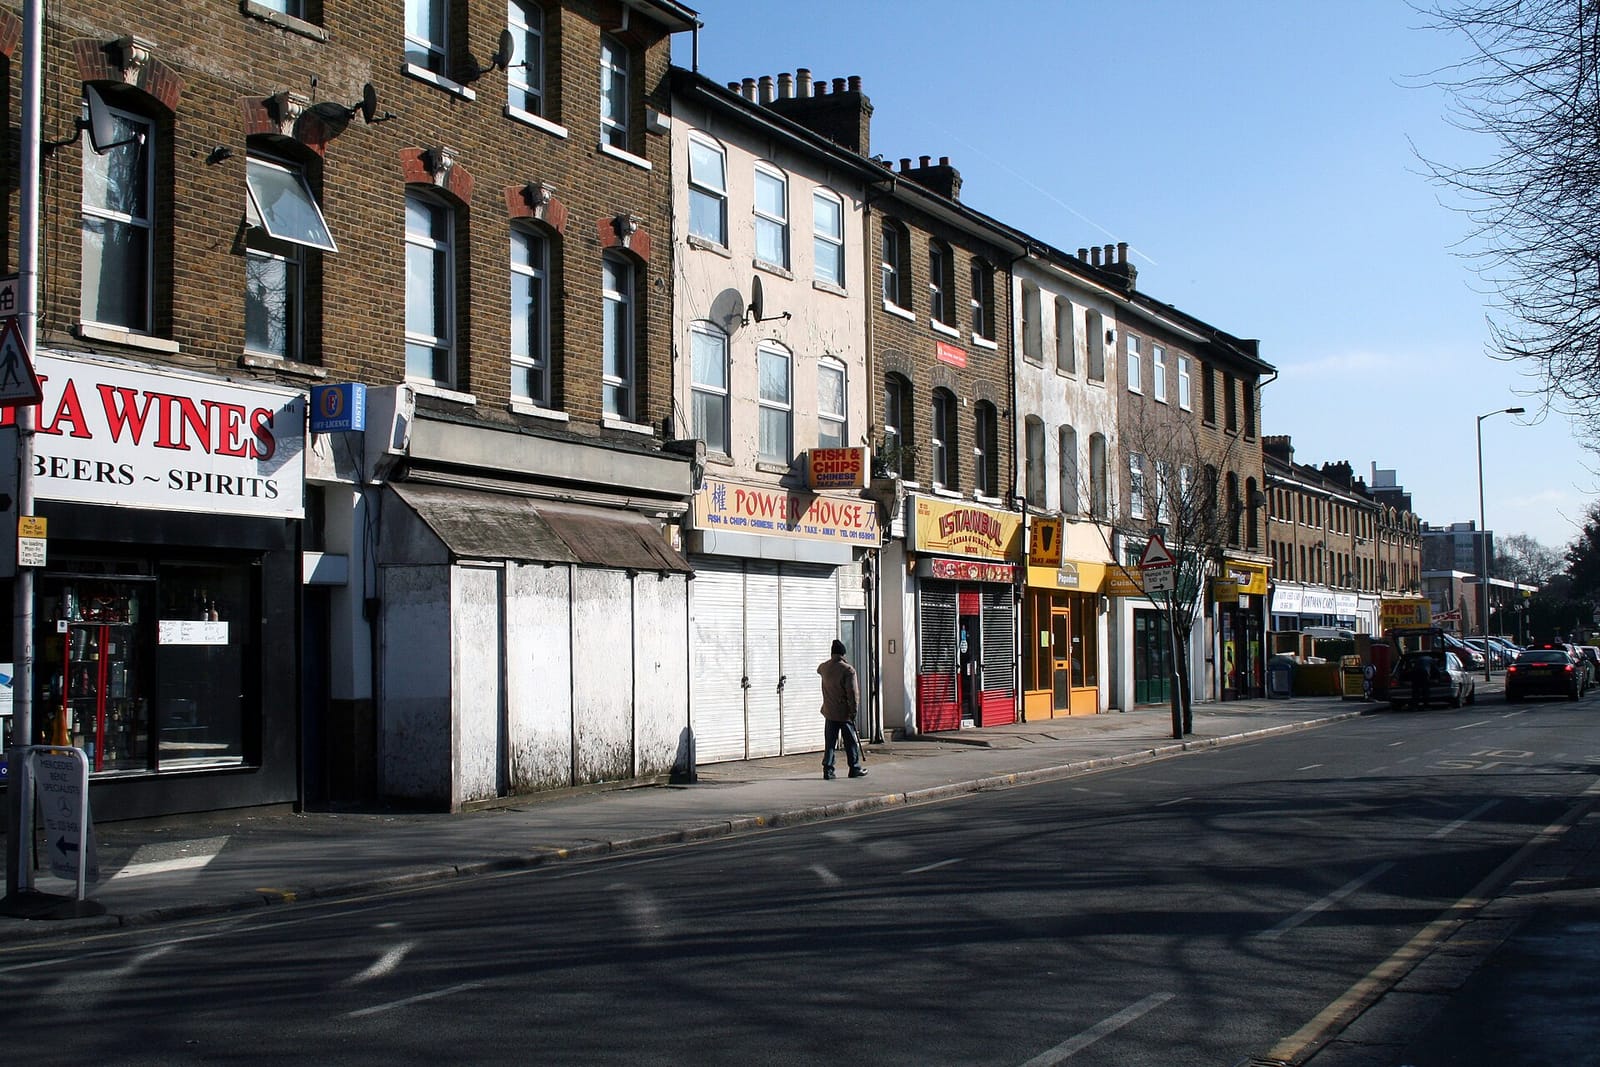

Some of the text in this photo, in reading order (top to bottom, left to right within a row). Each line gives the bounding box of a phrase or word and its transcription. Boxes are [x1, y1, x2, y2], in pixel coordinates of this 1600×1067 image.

[96, 384, 276, 461] WINES
[813, 448, 860, 461] FISH &
[813, 461, 860, 473] CHIPS
[33, 454, 135, 486] BEERS
[168, 469, 279, 499] SPIRITS
[707, 514, 721, 523] FISH
[730, 516, 747, 526] CHIPS
[735, 489, 862, 528] POWER HOUSE
[938, 509, 1004, 547] ISTANBUL
